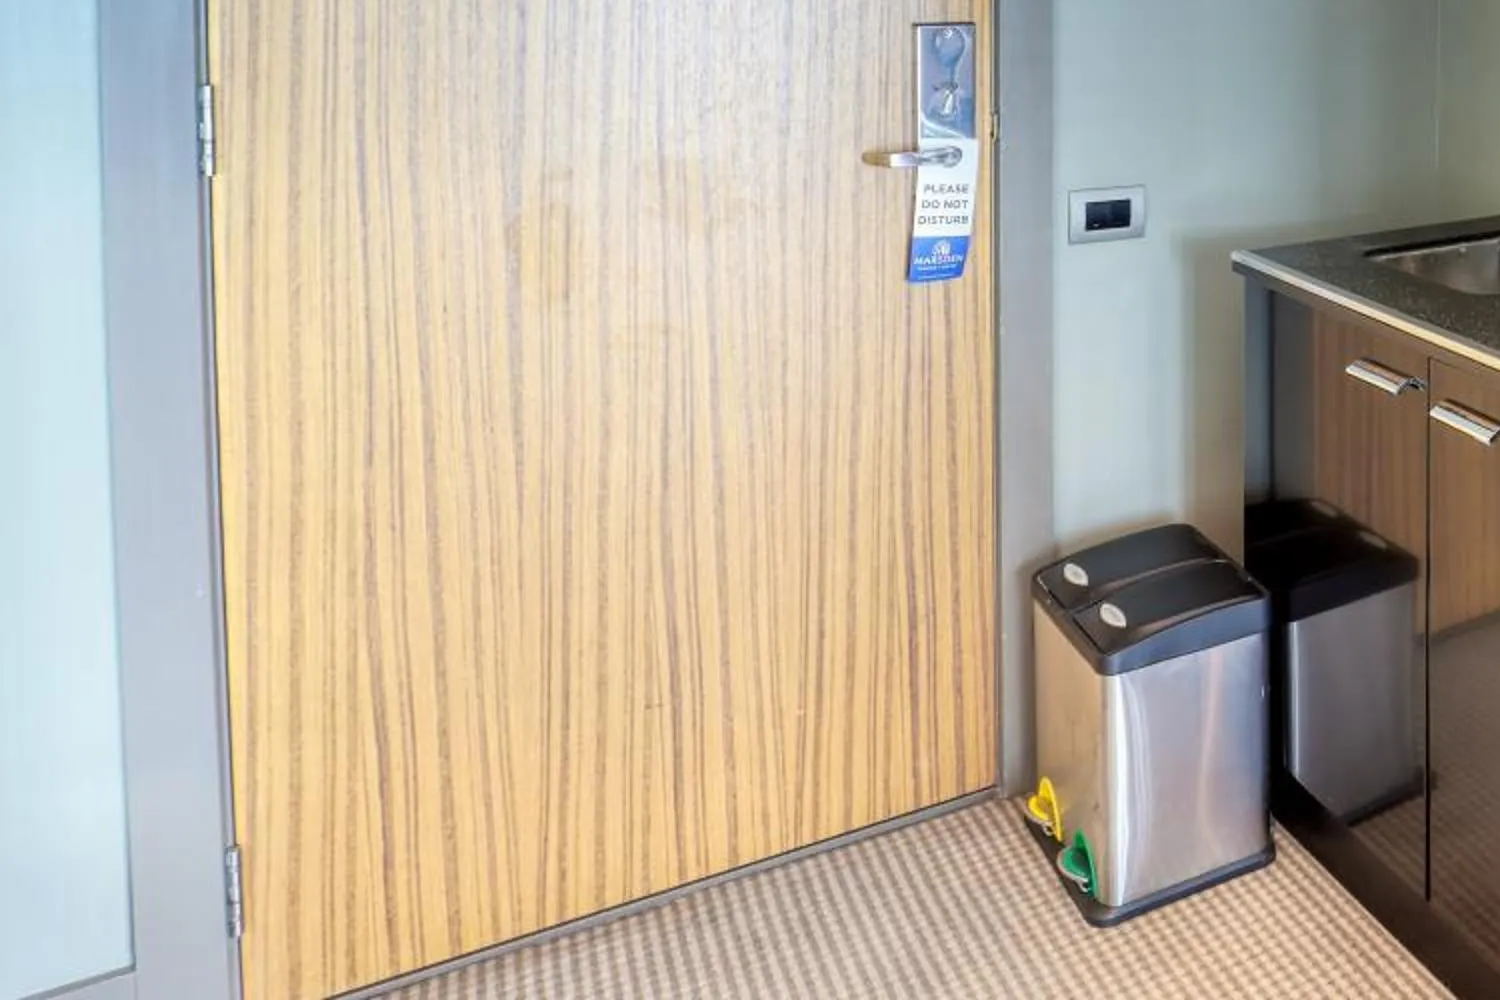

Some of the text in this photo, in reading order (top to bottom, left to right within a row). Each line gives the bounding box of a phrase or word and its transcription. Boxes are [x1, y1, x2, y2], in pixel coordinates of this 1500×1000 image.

[924, 183, 968, 194] PLEASE
[921, 199, 969, 209] DO NOT
[917, 215, 969, 225] DISTURB
